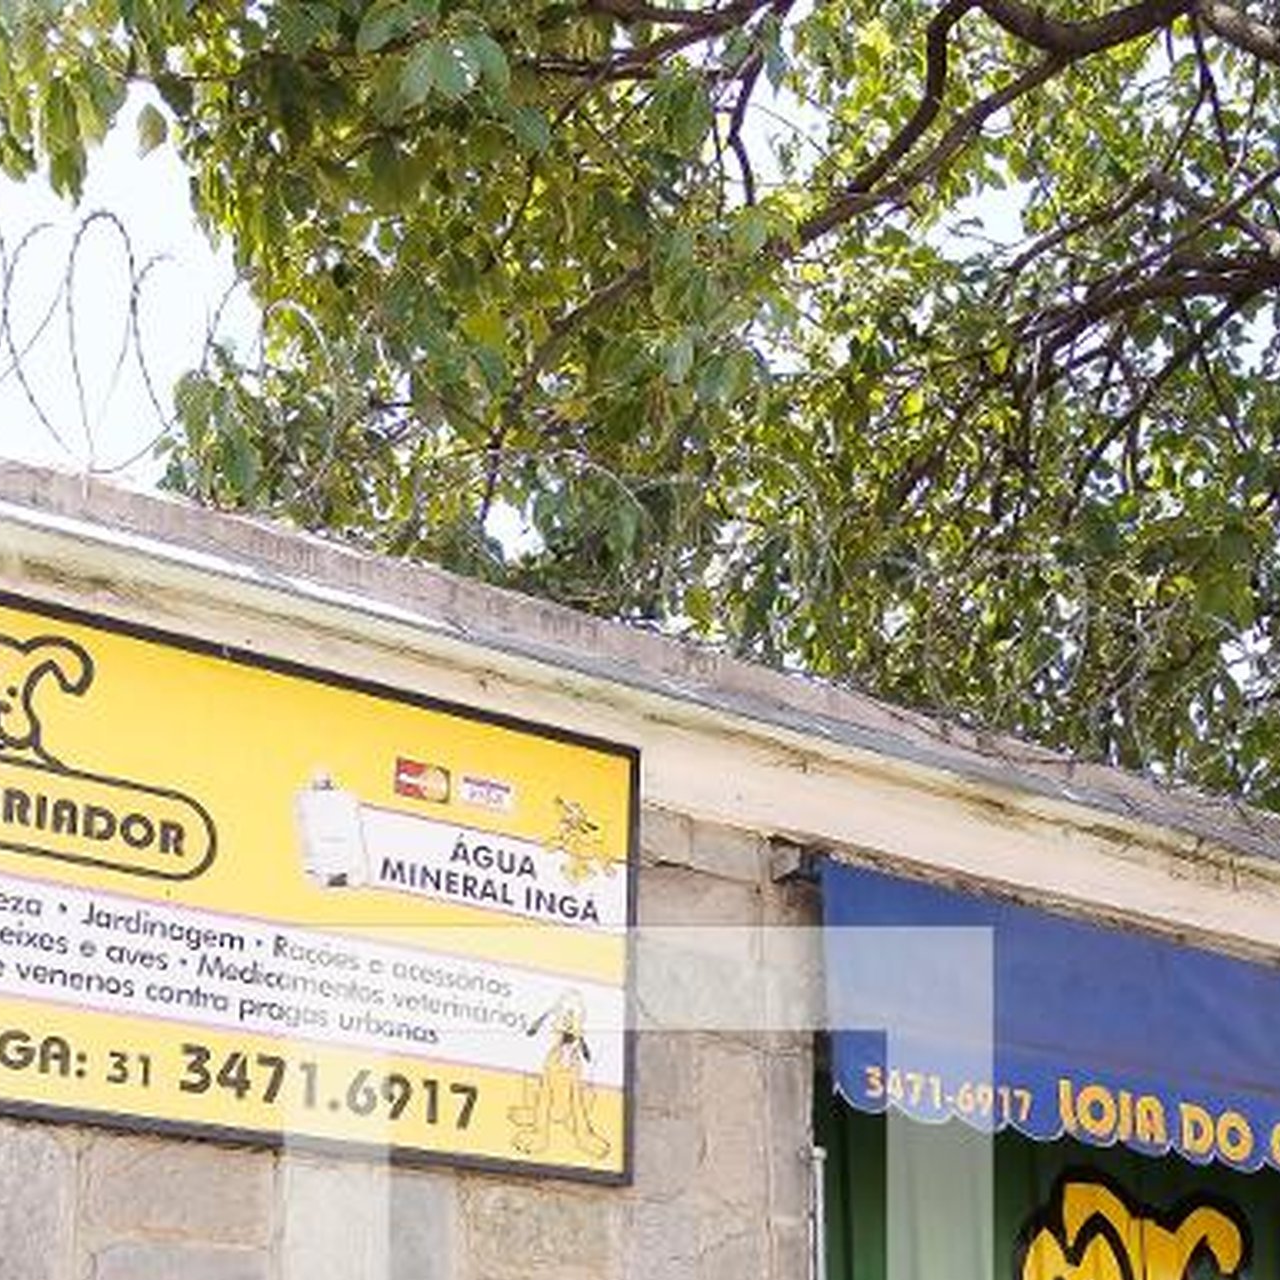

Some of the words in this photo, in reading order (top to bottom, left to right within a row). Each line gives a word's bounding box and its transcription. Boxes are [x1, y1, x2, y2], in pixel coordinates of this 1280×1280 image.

[379, 856, 515, 906] MINERAL
[449, 831, 538, 880] ÁGUA
[79, 939, 97, 958] e
[105, 944, 168, 972] aves
[196, 953, 385, 1006] Medicamentos
[81, 901, 245, 951] Jardinagem
[369, 958, 384, 975] e
[15, 962, 135, 998] venenos
[145, 982, 229, 1012] contra
[238, 998, 328, 1029] pragas
[338, 1011, 440, 1045] urbanas
[106, 1050, 152, 1087] 31
[178, 1043, 479, 1131] 3471.6917
[863, 1065, 1032, 1123] 3471-6917
[1057, 1077, 1168, 1145] LOJA
[1178, 1100, 1255, 1165] DO
